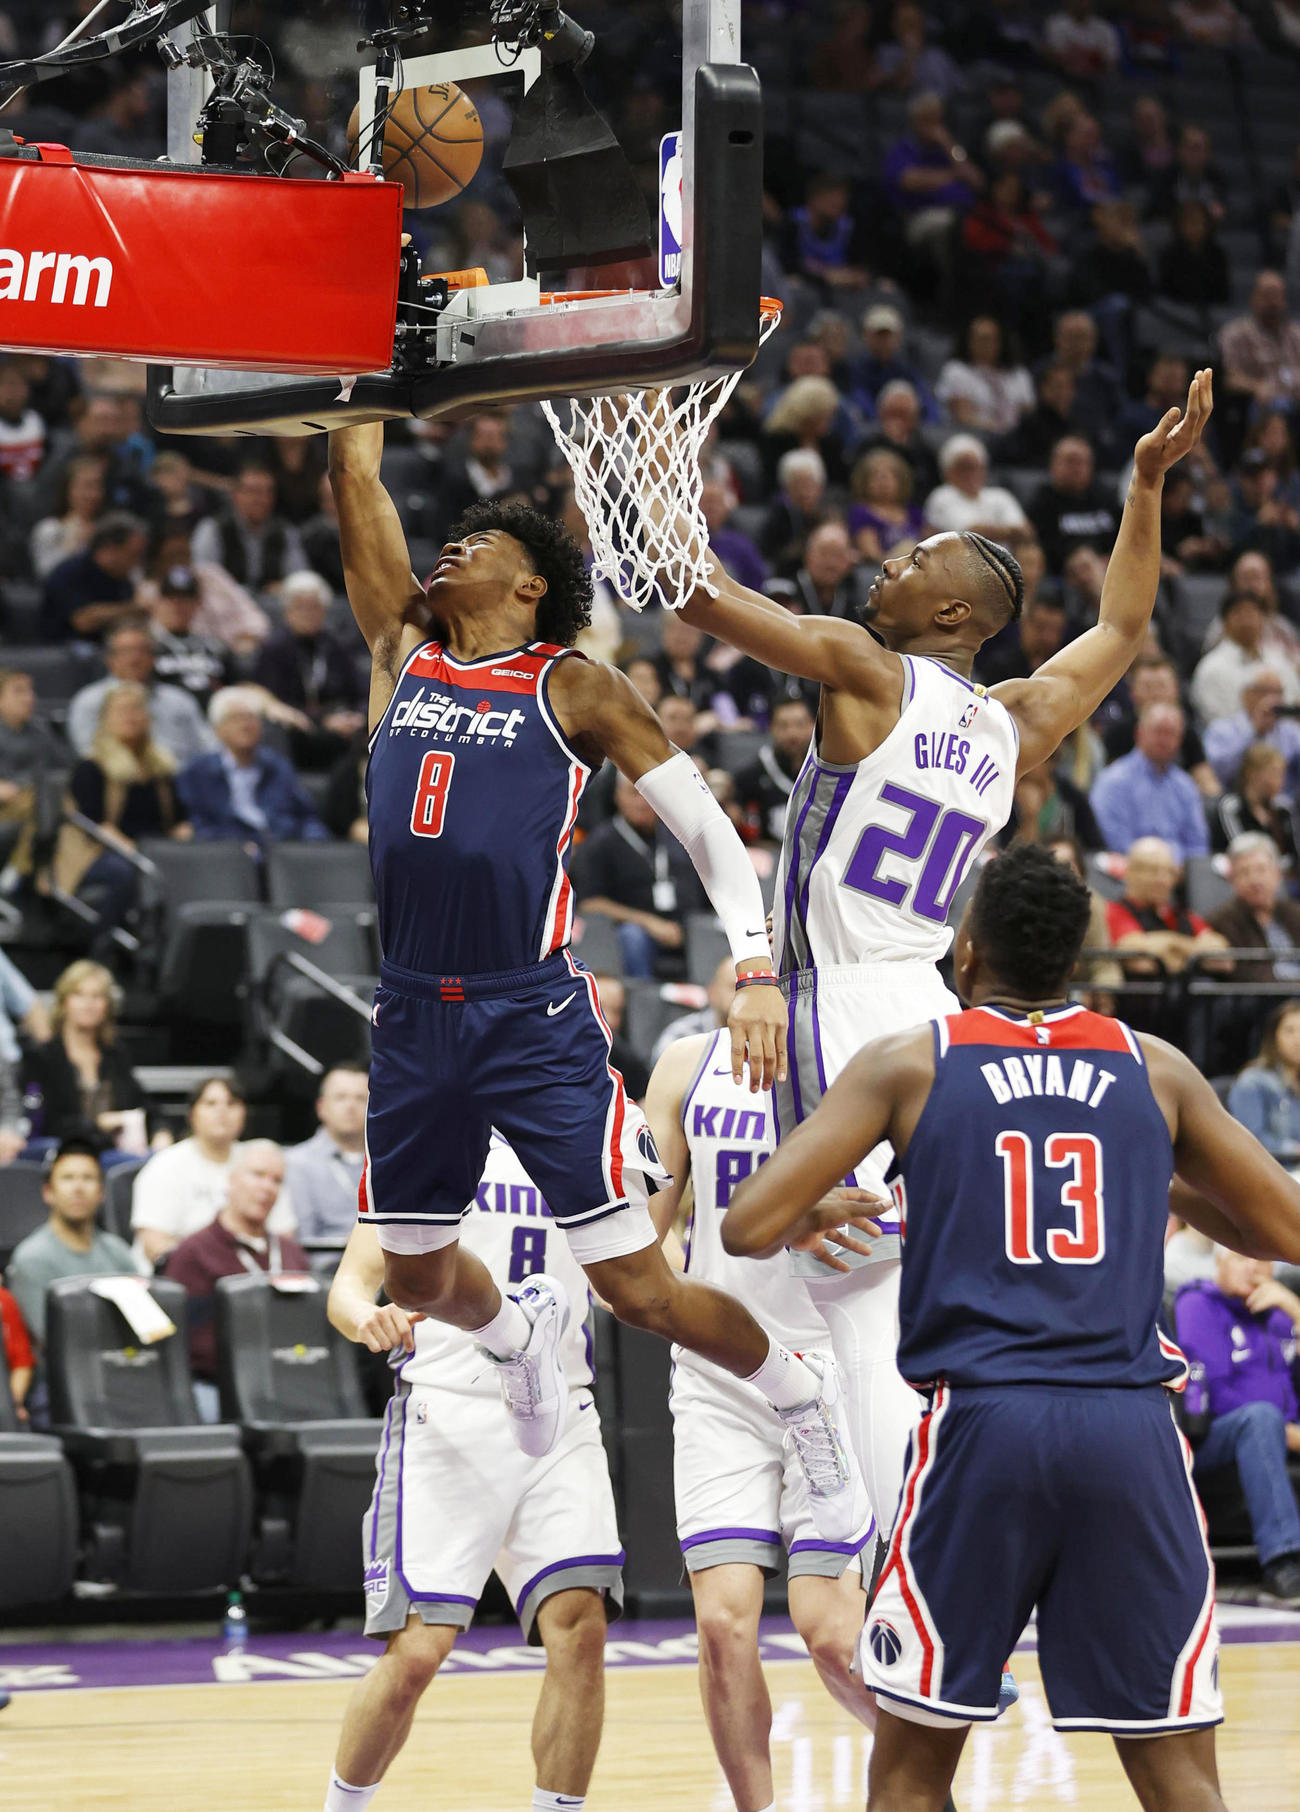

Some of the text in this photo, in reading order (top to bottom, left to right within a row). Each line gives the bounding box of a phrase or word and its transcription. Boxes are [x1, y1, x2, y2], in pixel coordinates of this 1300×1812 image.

[429, 692, 453, 705] THE
[490, 668, 535, 680] GEICO
[391, 686, 526, 740] district
[409, 728, 514, 748] COLUMBIA
[914, 731, 1000, 797] GILES III
[409, 749, 456, 839] 8
[839, 780, 988, 926] 20
[979, 1054, 1117, 1108] BRYANT
[715, 1149, 771, 1210] 8
[995, 1130, 1106, 1265] 13
[508, 1225, 547, 1284] 8
